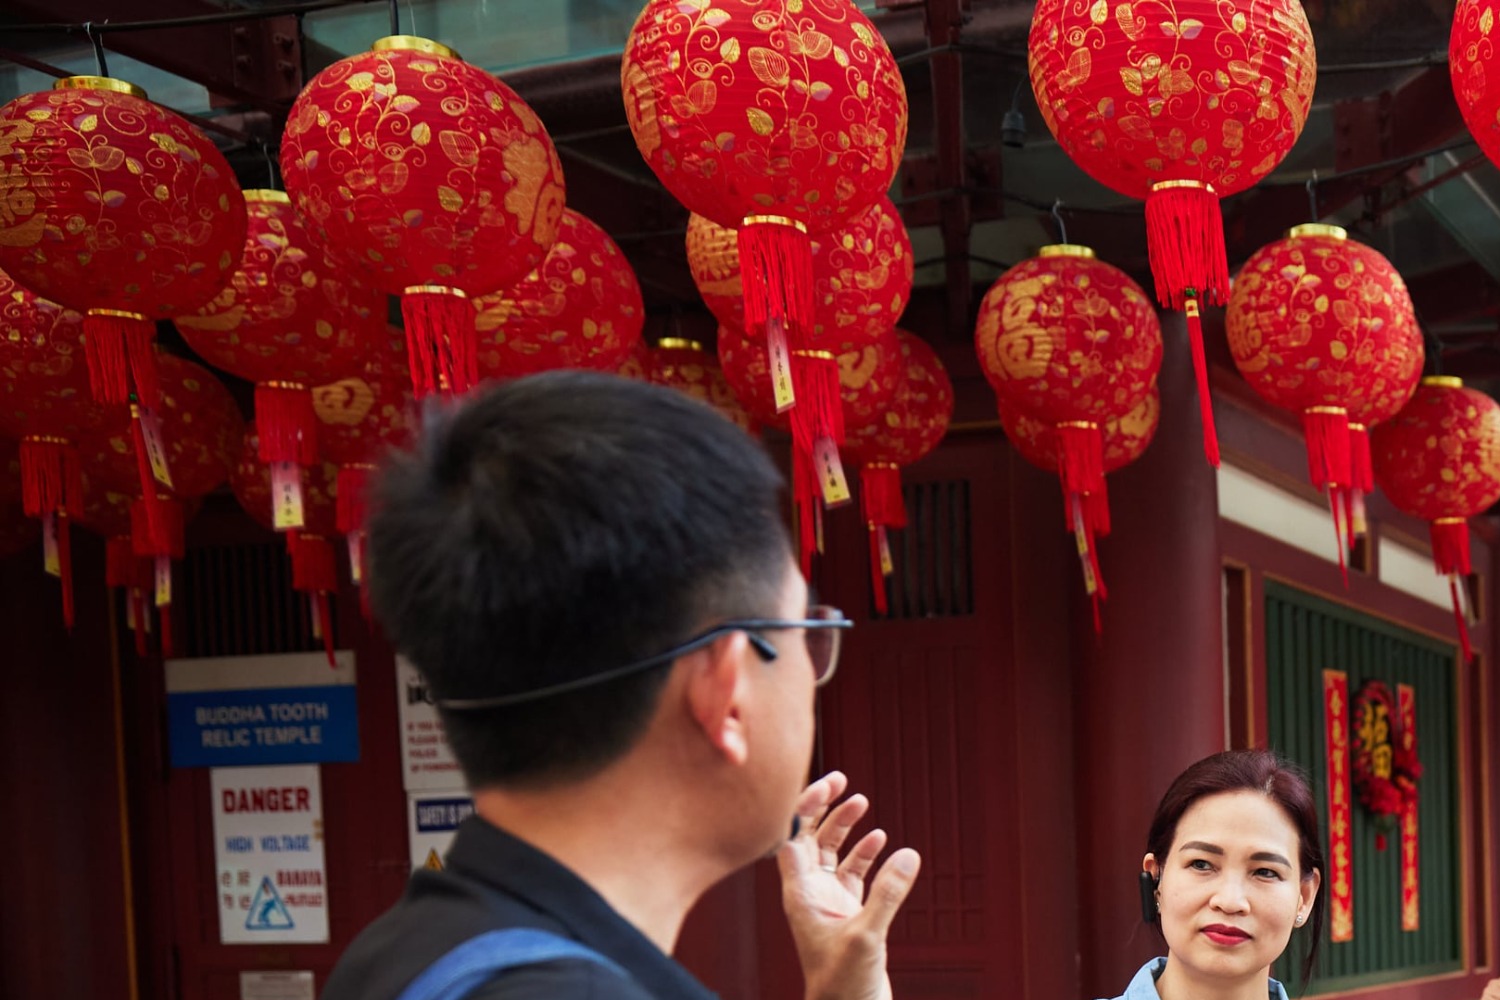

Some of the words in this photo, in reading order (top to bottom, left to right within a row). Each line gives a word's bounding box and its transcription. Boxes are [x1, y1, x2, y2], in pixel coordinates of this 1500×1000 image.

[195, 704, 265, 725] BUDDHA
[269, 702, 328, 721] TOOTH
[201, 729, 250, 747] RELIC
[254, 726, 322, 745] TEMPLE
[222, 786, 310, 813] DANGER
[225, 836, 253, 852] HIGH
[261, 834, 310, 852] VOLTAGE
